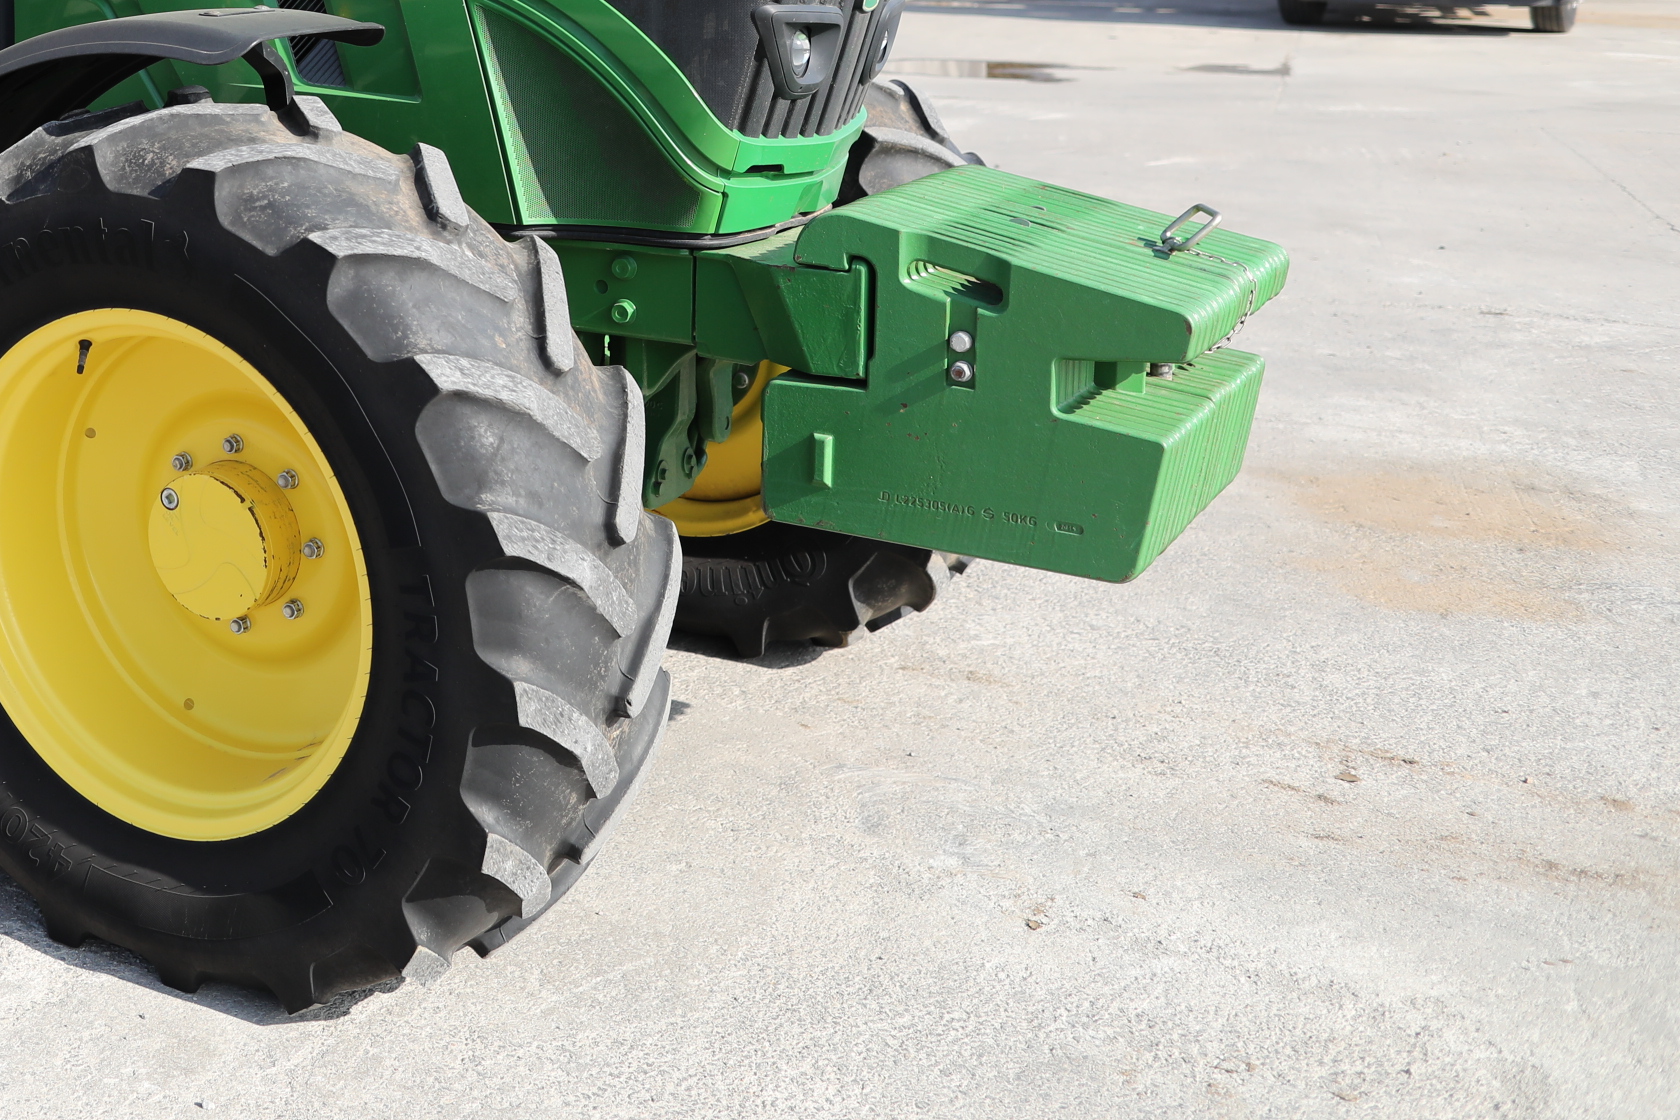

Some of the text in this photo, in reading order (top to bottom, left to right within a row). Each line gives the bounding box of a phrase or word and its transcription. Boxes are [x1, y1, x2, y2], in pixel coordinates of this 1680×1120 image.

[1002, 511, 1038, 527] 50KG
[680, 544, 828, 606] Contine
[332, 572, 440, 887] TRACTOR 70
